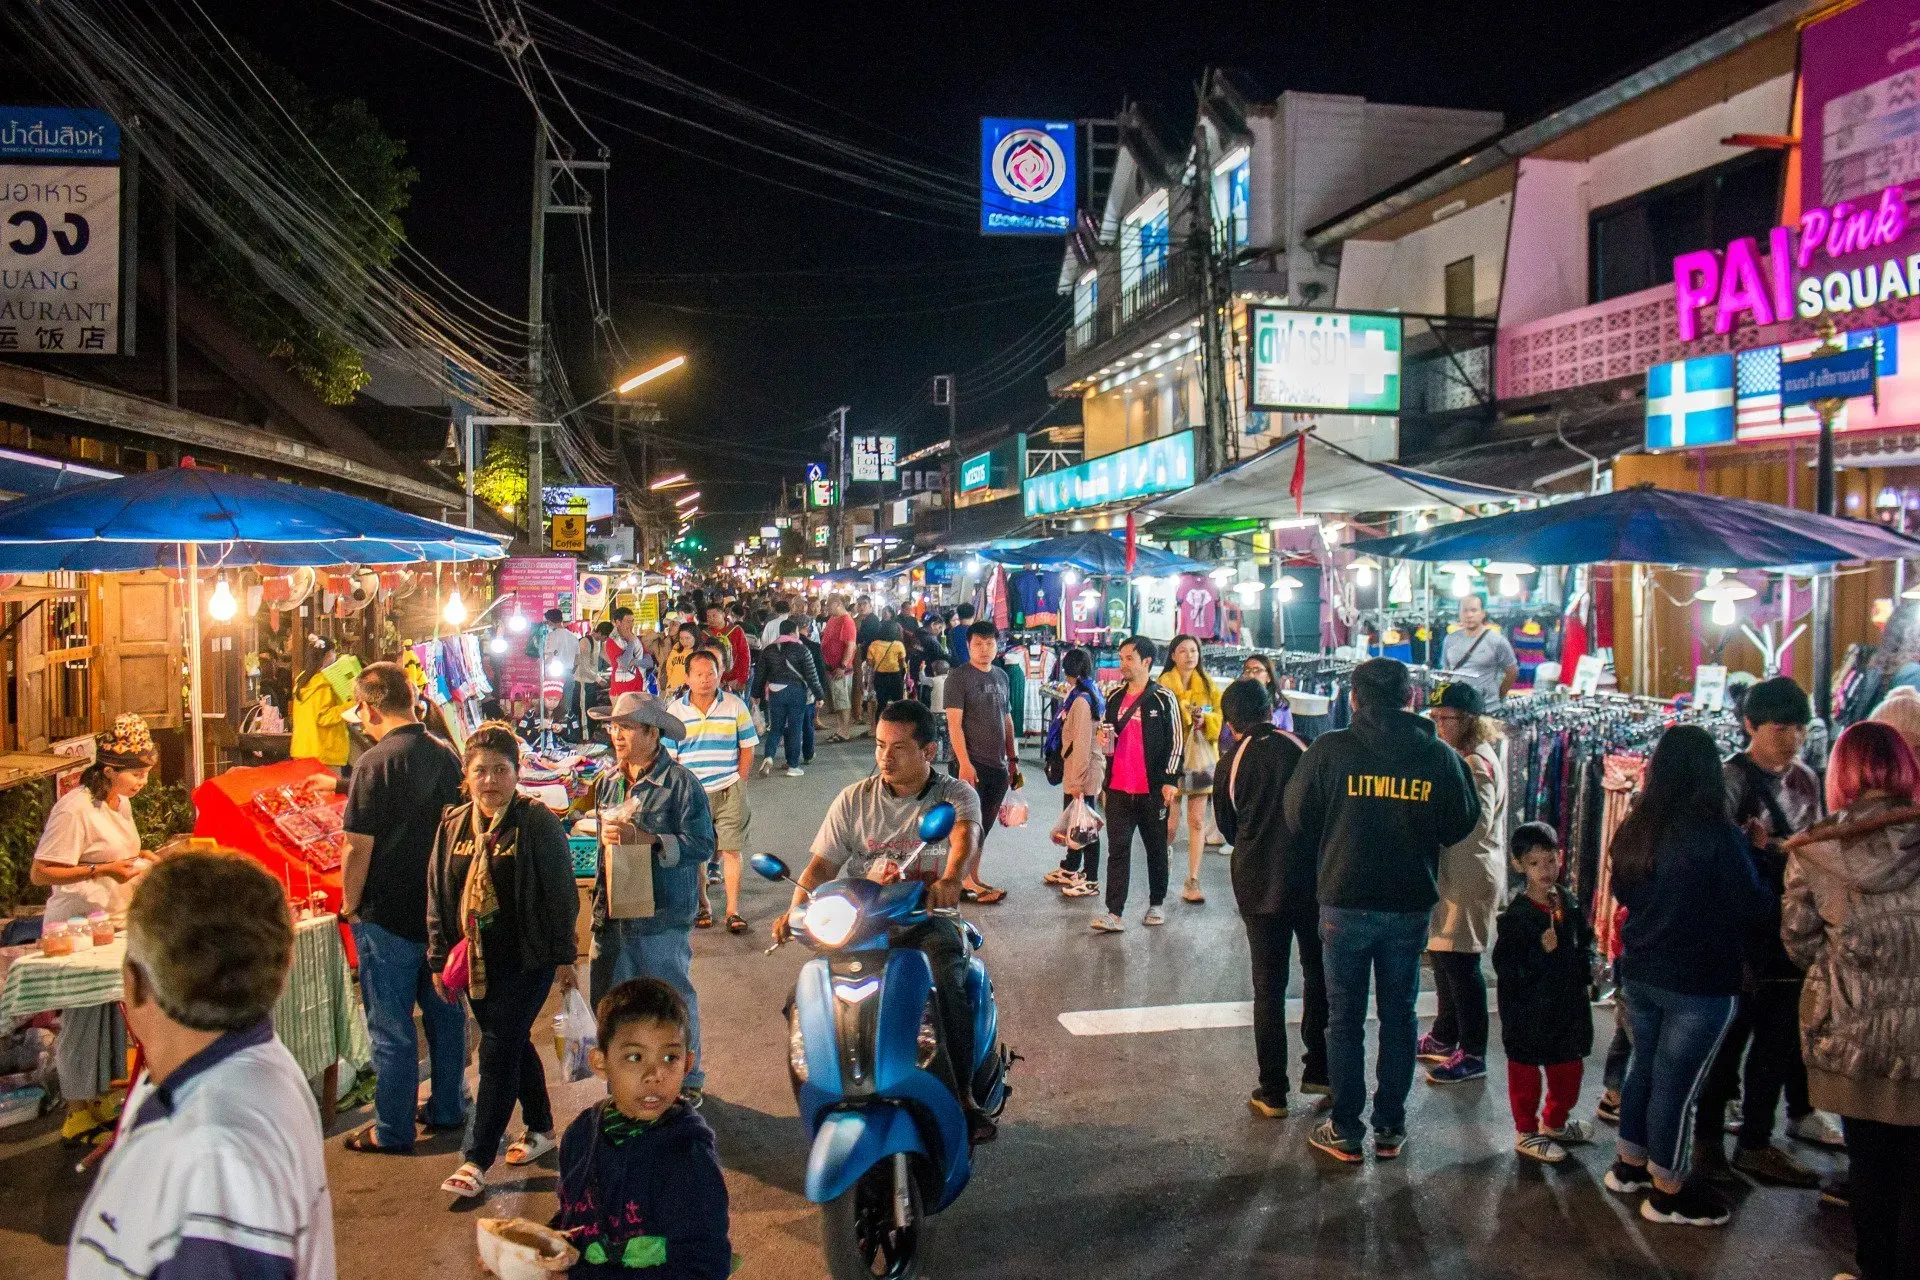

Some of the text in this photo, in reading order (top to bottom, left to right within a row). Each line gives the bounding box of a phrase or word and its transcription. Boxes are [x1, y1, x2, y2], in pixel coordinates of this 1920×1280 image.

[1798, 187, 1906, 268] Pink
[1673, 226, 1794, 342] PAI
[555, 540, 582, 549] Coffee
[1347, 774, 1432, 802] LITWILLER
